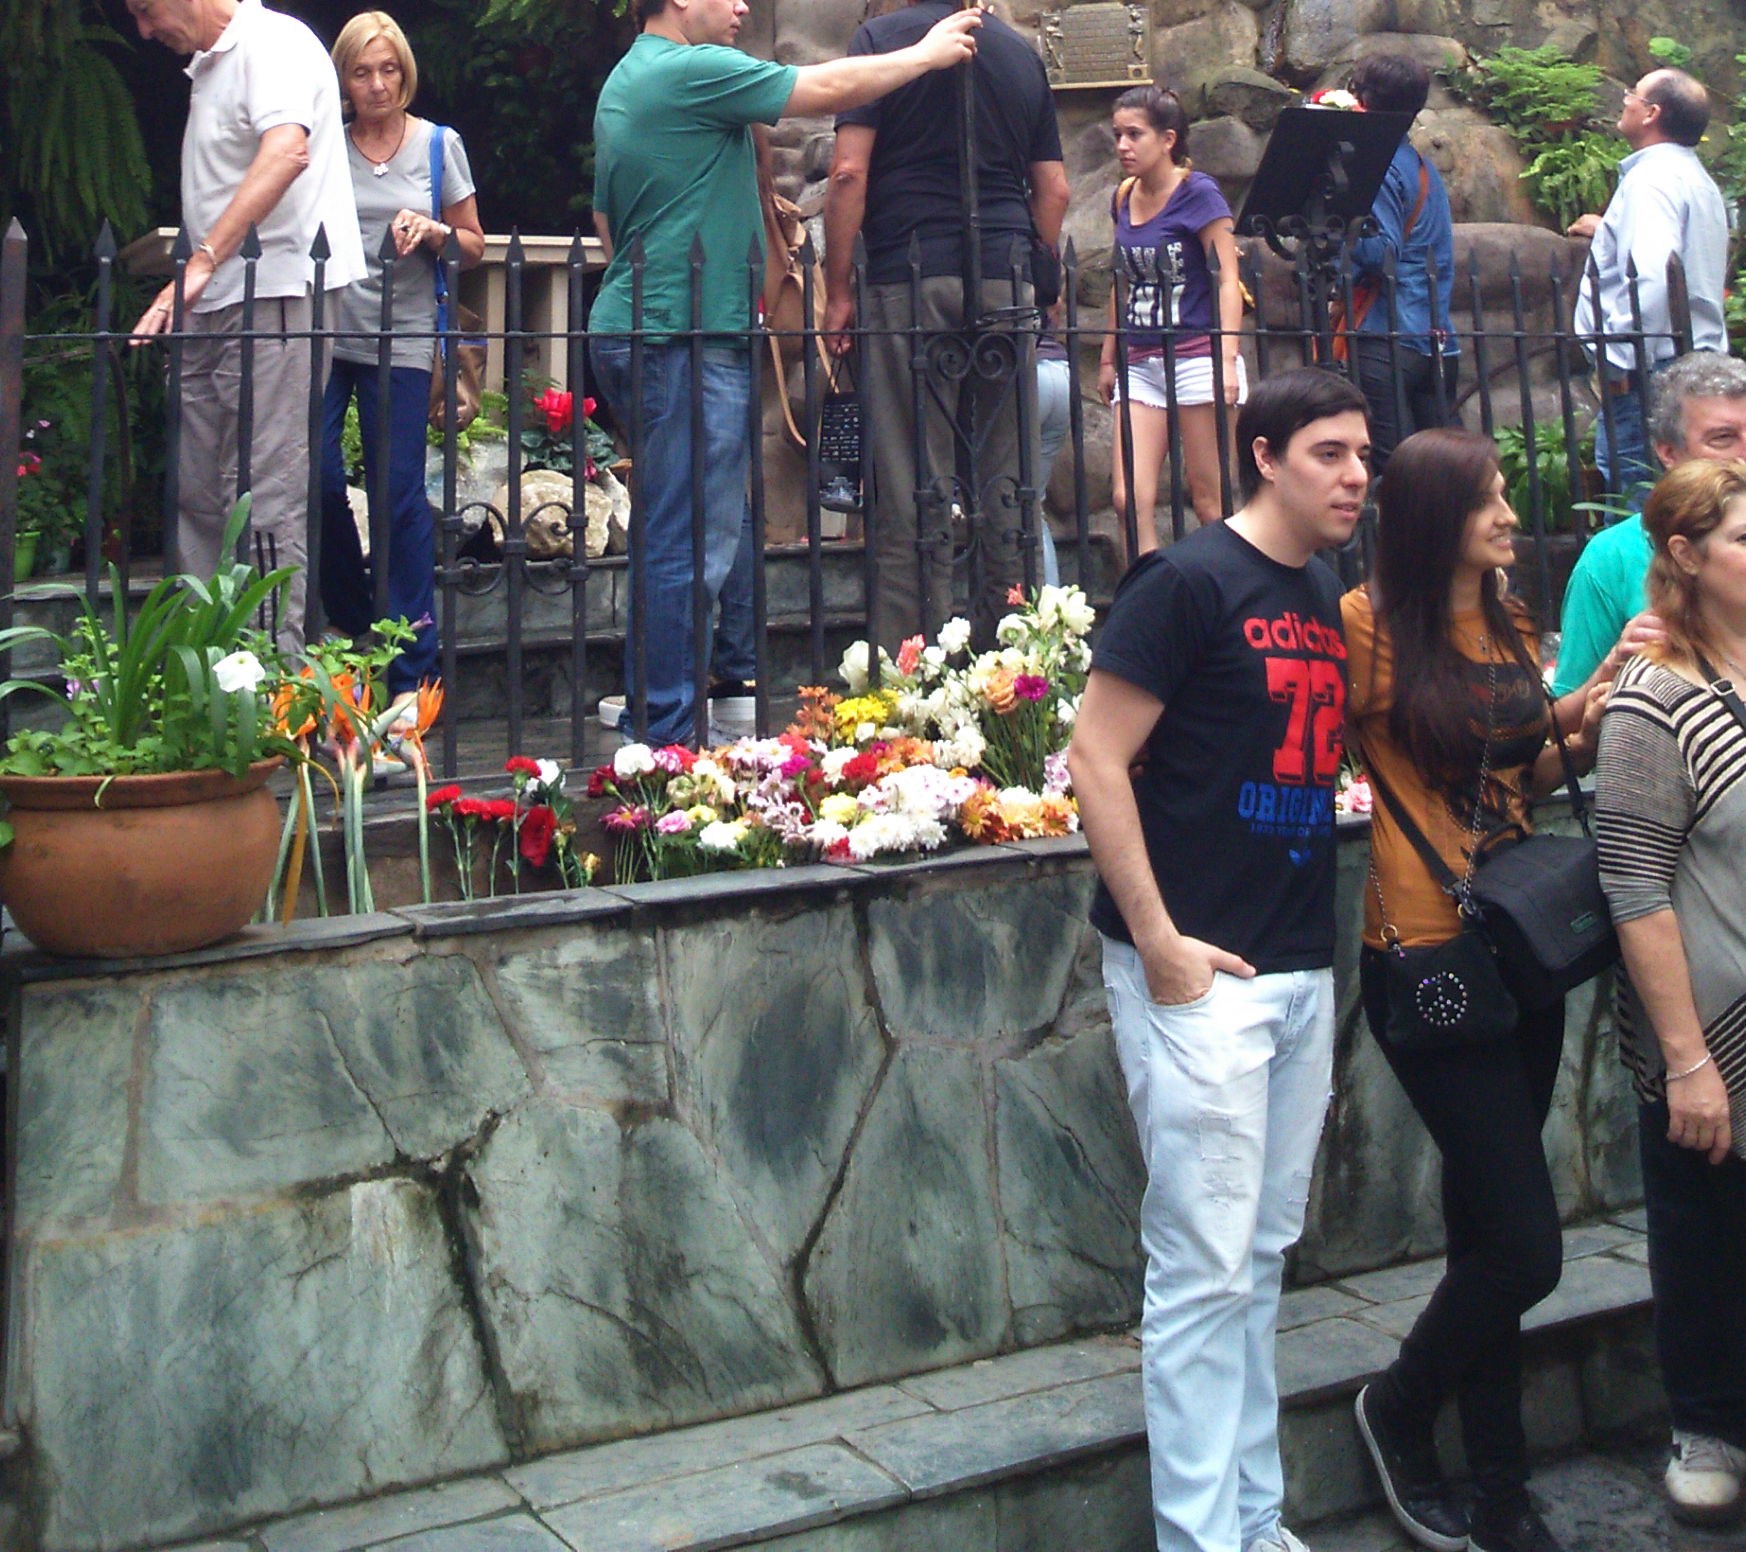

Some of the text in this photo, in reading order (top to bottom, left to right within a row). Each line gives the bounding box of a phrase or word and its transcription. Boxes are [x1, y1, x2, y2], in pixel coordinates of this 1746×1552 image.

[1243, 611, 1348, 660] adidas
[1264, 656, 1346, 786] 72
[1238, 780, 1332, 826] ORIGIN
